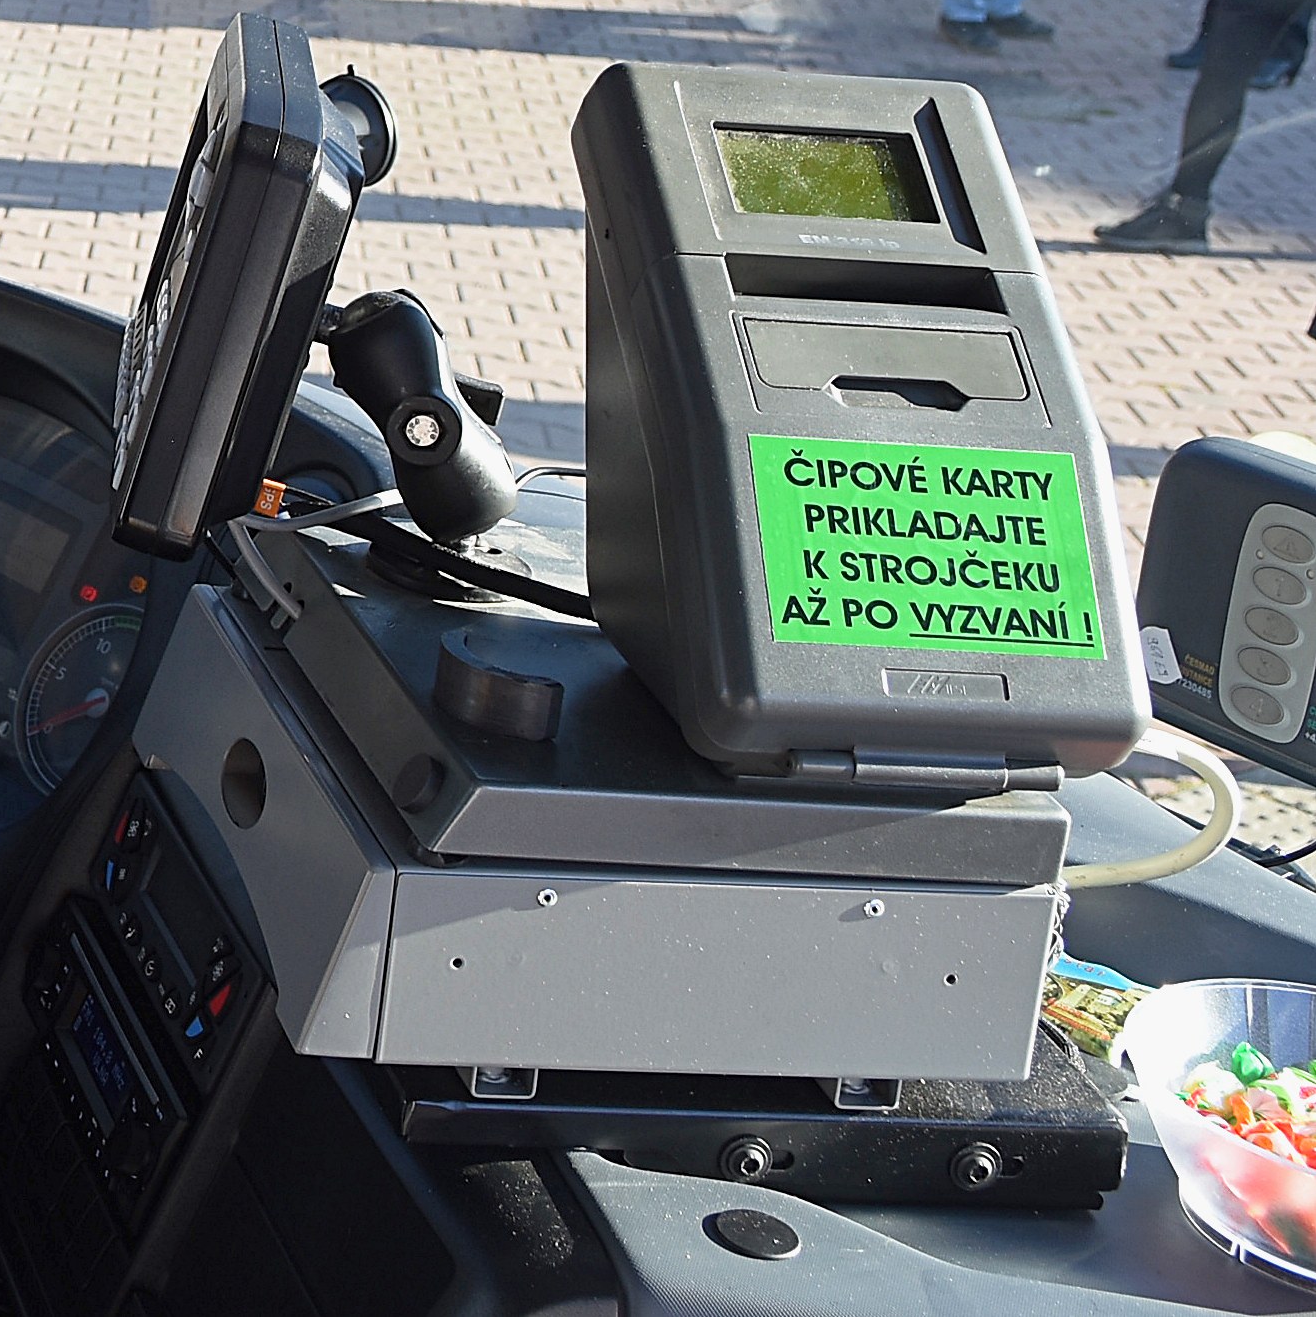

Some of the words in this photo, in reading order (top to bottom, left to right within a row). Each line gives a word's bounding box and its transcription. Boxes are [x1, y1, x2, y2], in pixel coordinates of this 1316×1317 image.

[784, 449, 928, 494] ČIPOVÉ
[941, 466, 1053, 501] KARTY
[804, 504, 1047, 546] PRIKLADAJTE
[803, 550, 829, 580] K
[840, 550, 1060, 593] STROJČEKU
[781, 587, 831, 627] AŽ
[842, 598, 899, 630] PO
[909, 601, 1069, 640] VYZVANÍ
[1083, 612, 1094, 641] !
[96, 637, 112, 655] 10
[55, 666, 67, 681] 5
